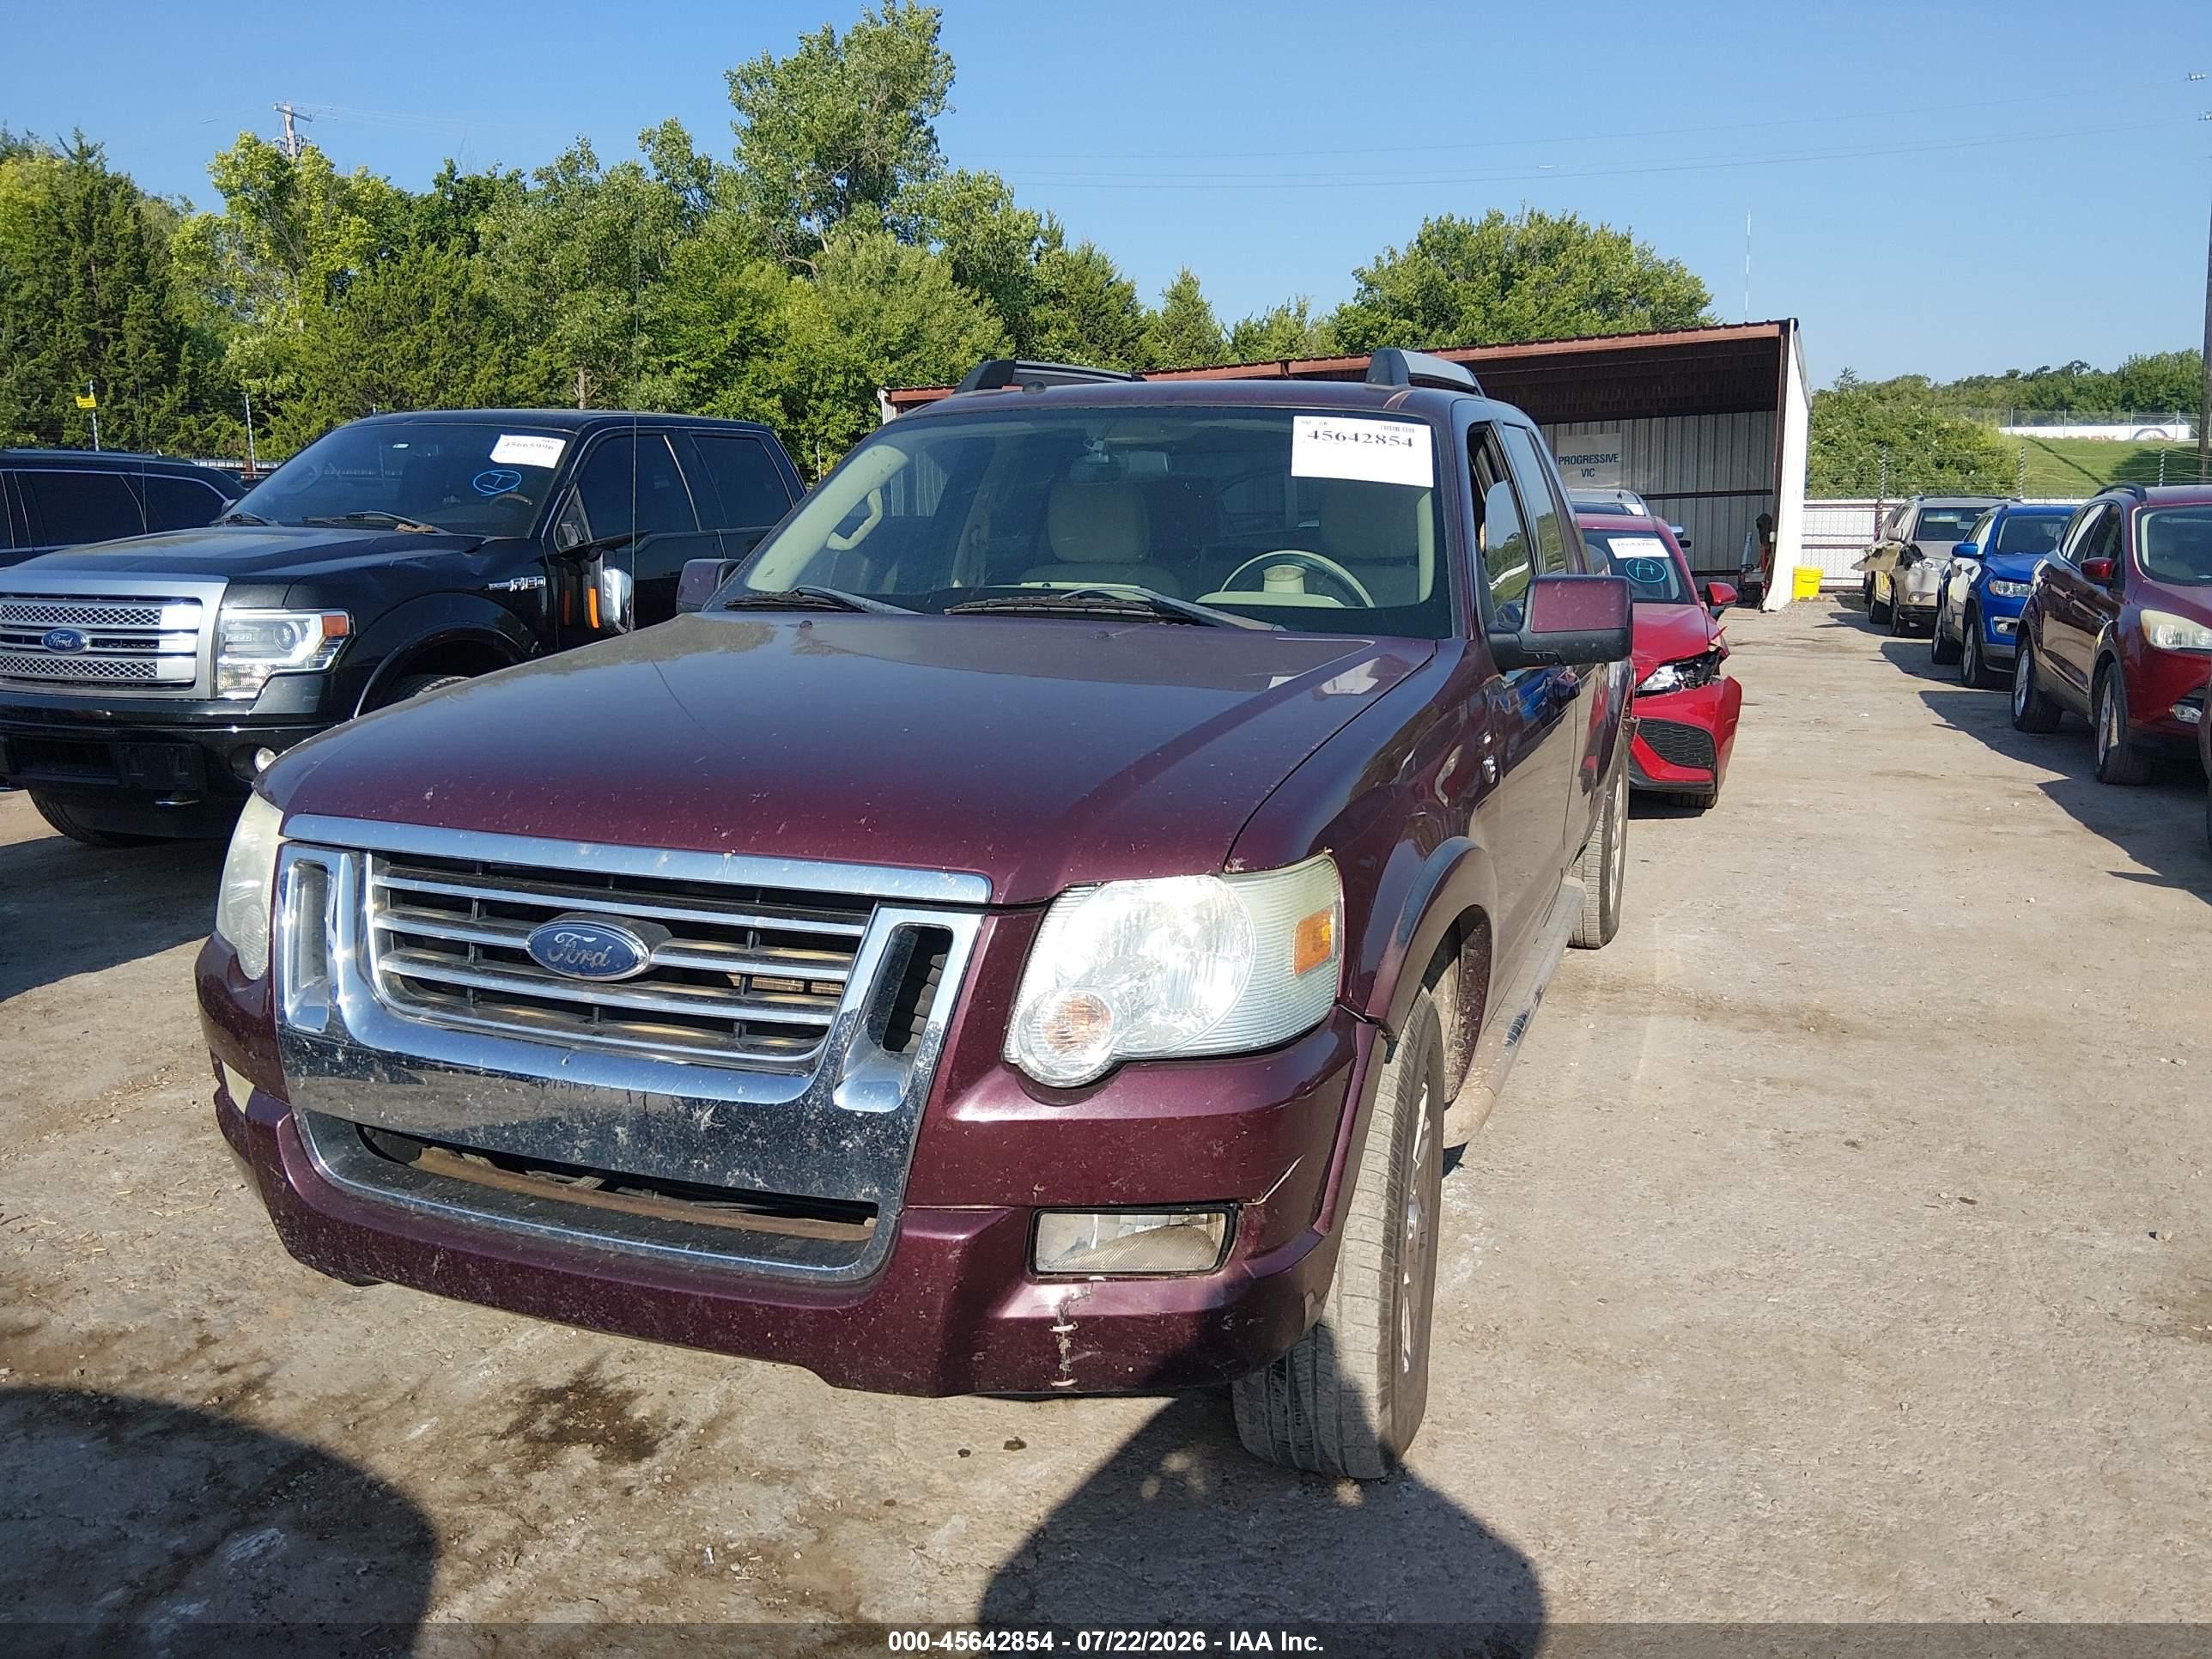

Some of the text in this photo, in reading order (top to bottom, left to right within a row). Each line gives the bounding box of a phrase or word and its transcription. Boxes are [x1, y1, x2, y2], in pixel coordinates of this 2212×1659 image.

[1307, 429, 1413, 447] 45642854
[1559, 453, 1620, 465] PROGRESSIVE
[1581, 468, 1595, 477] VIC
[48, 632, 74, 647] Ford
[547, 932, 613, 968] Ford
